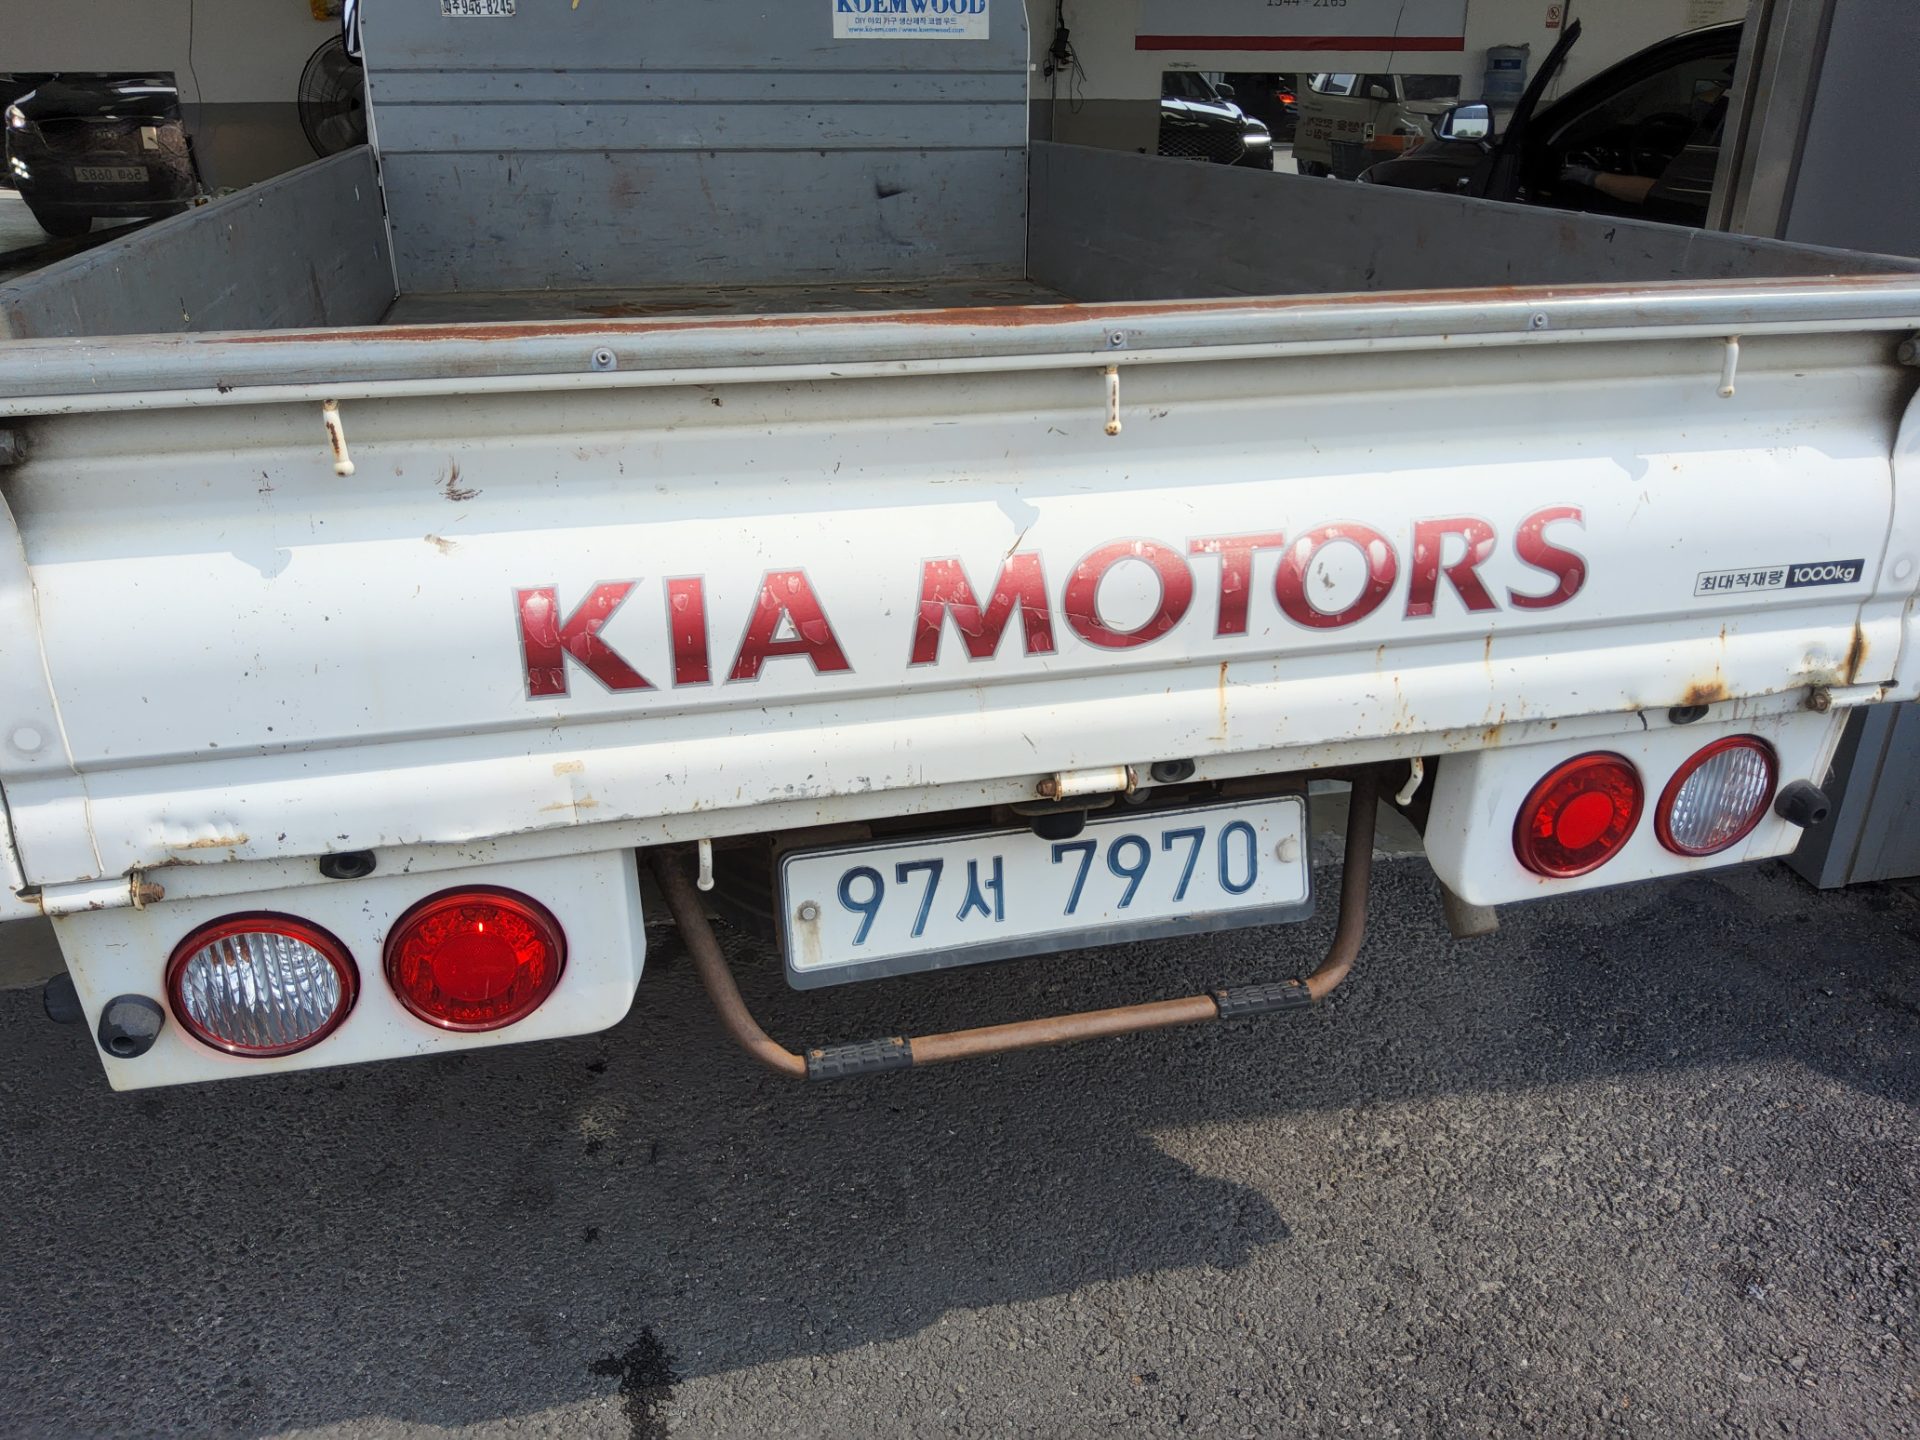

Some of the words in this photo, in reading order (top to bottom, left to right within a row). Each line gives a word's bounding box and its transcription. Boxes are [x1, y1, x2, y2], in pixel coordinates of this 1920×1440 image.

[511, 567, 857, 701] KIA
[907, 502, 1589, 668] MOTORS
[1700, 570, 1784, 590] 최대적재량
[1793, 565, 1855, 582] 1000kg
[837, 855, 1005, 946] 97서
[1050, 820, 1258, 916] 7970
